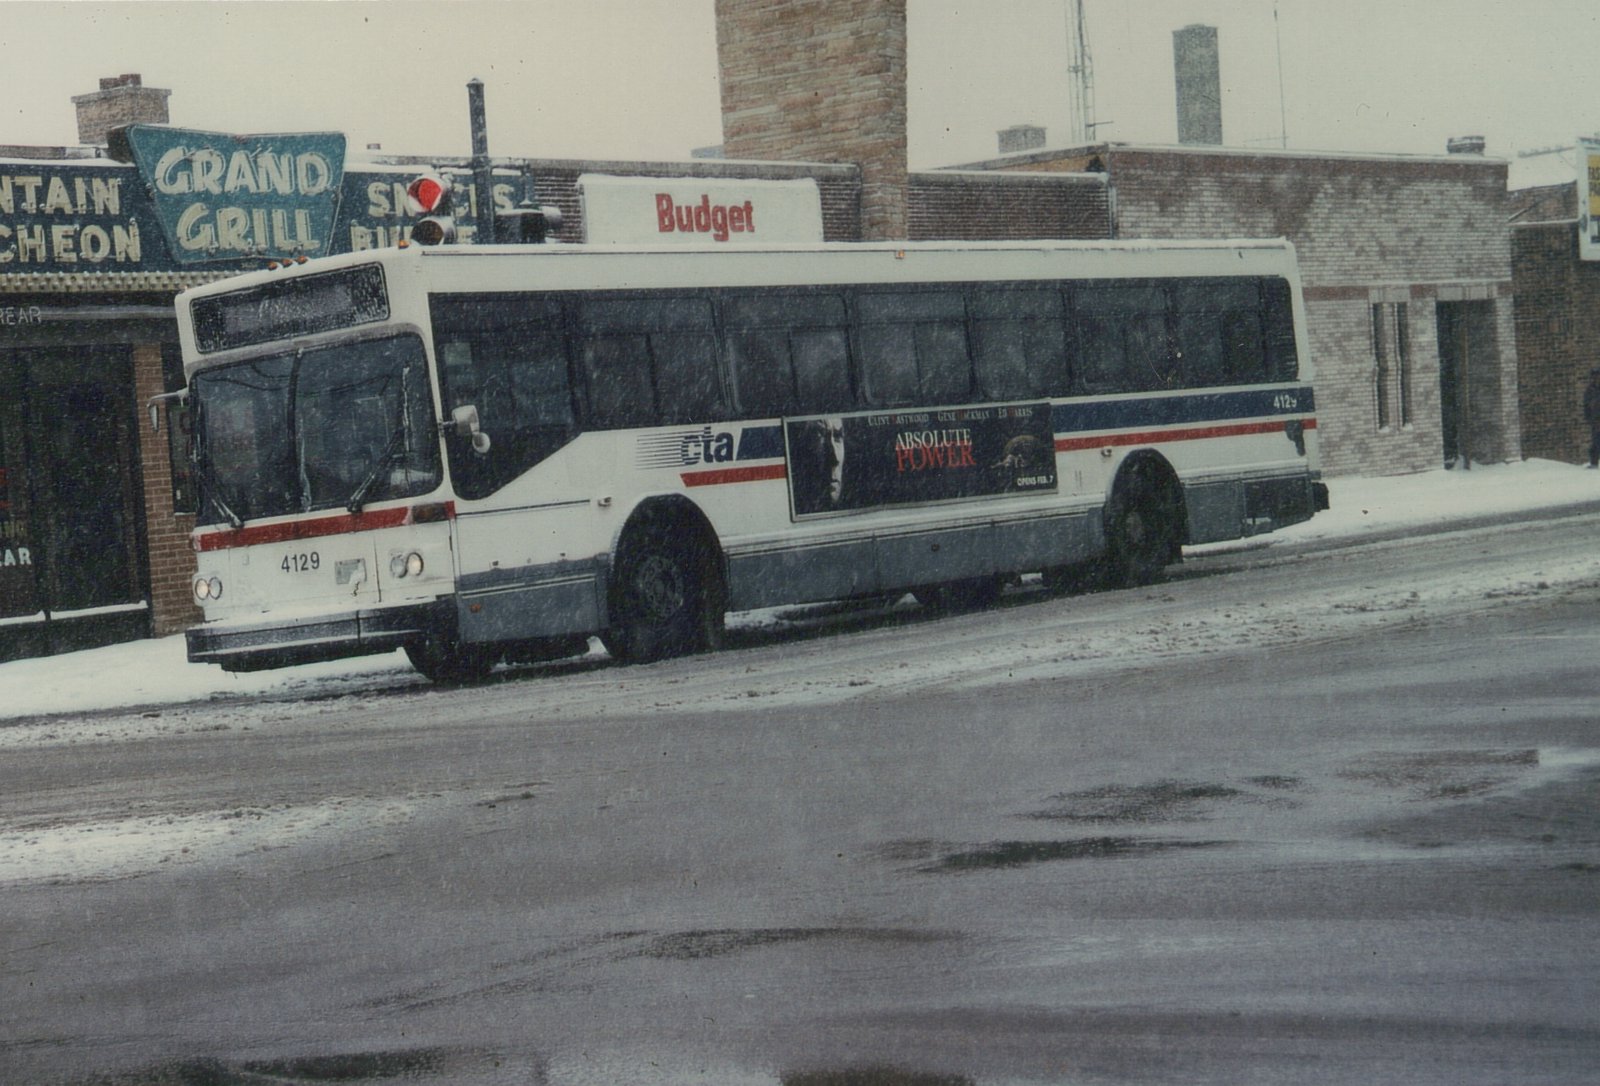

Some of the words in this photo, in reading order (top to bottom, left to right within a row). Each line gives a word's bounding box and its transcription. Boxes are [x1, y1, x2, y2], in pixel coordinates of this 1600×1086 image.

[154, 146, 333, 195] GRAND
[176, 202, 321, 249] GRILL
[655, 193, 755, 241] Budget
[1273, 394, 1298, 409] 4129
[681, 426, 734, 465] cta
[895, 428, 972, 450] ABSOLUTE
[896, 440, 977, 472] POWER
[0, 547, 32, 566] AR
[281, 551, 320, 573] 4129
